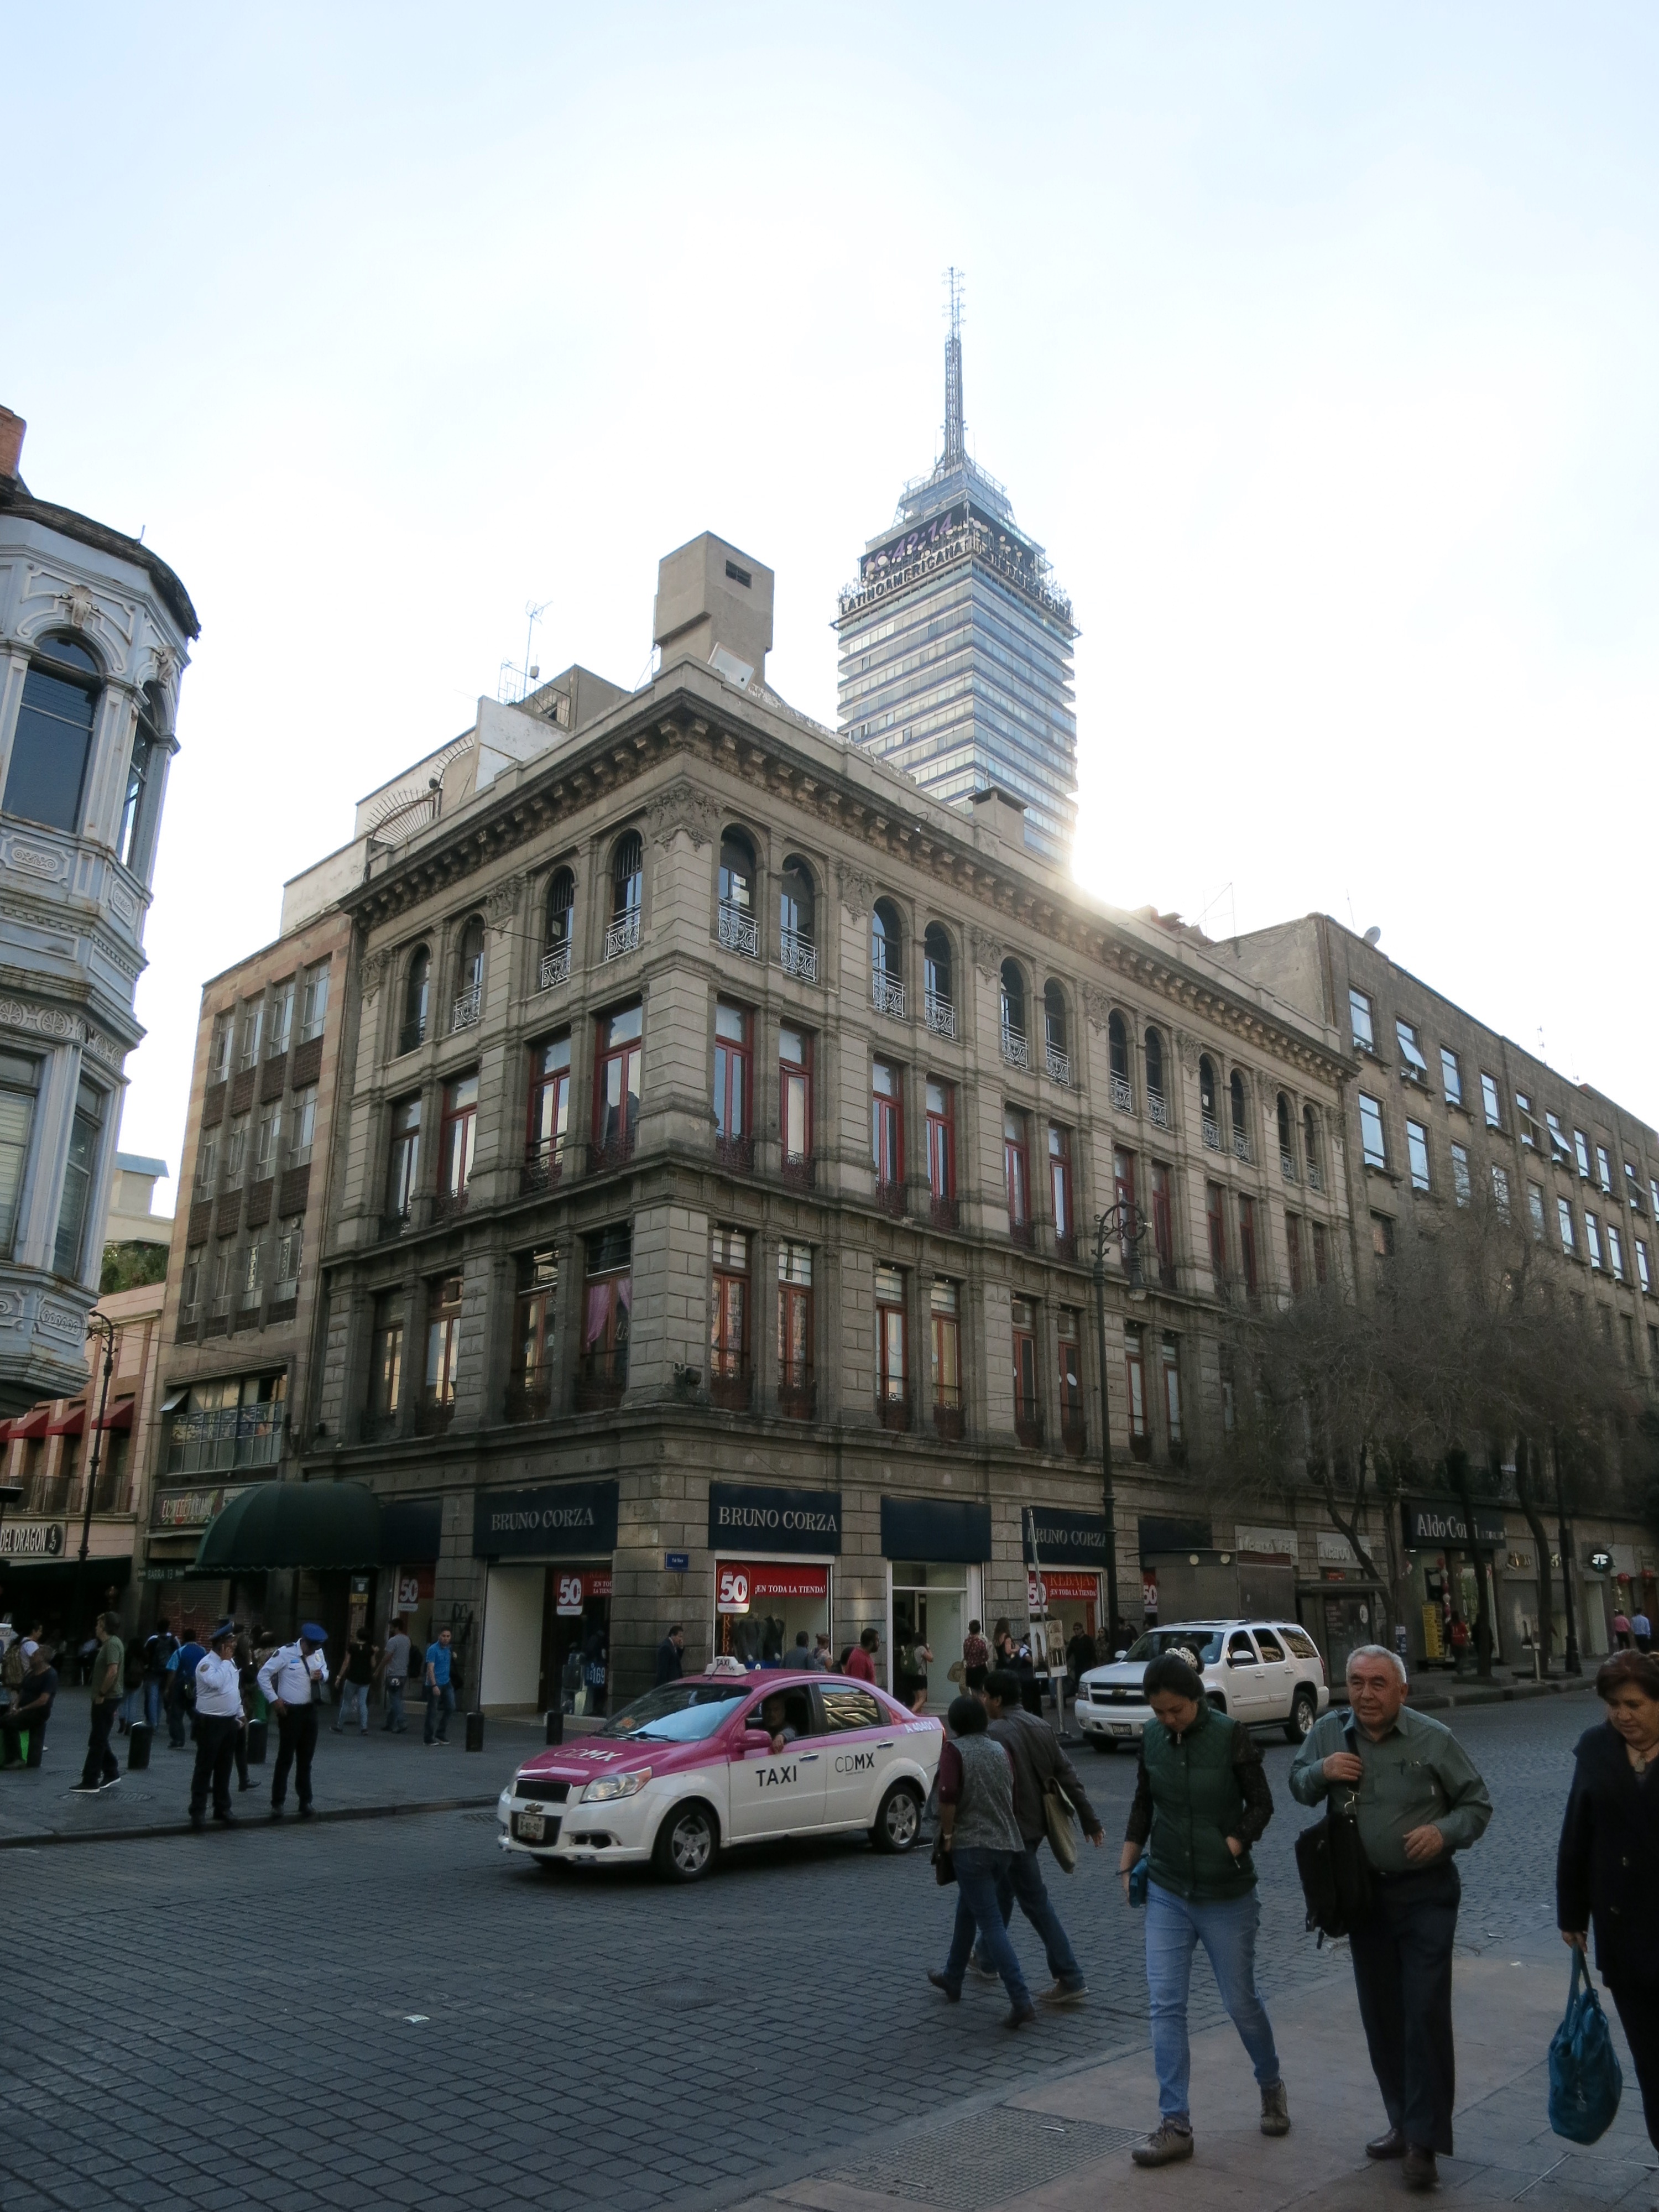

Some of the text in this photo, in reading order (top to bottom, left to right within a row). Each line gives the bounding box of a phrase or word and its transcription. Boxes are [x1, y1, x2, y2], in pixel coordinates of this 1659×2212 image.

[840, 541, 963, 615] LATINOAMERICANA
[247, 1246, 258, 1290] TATTOO
[491, 1507, 595, 1531] BRUNO CORZA
[718, 1506, 838, 1532] BRUNO CORZA
[1417, 1514, 1446, 1537] Aldo
[1447, 1516, 1479, 1539] Coi
[0, 1527, 48, 1552] DEL DRAGON
[755, 1584, 766, 1594] ¡EN
[768, 1585, 787, 1593] TODA
[798, 1585, 826, 1594] TIENDA!
[1050, 1572, 1097, 1589] REBAJAS
[722, 1615, 731, 1653] REB
[904, 1724, 914, 1734] A
[554, 1748, 624, 1762] CDMX
[835, 1752, 875, 1772] CDMX
[756, 1765, 797, 1787] TAXI
